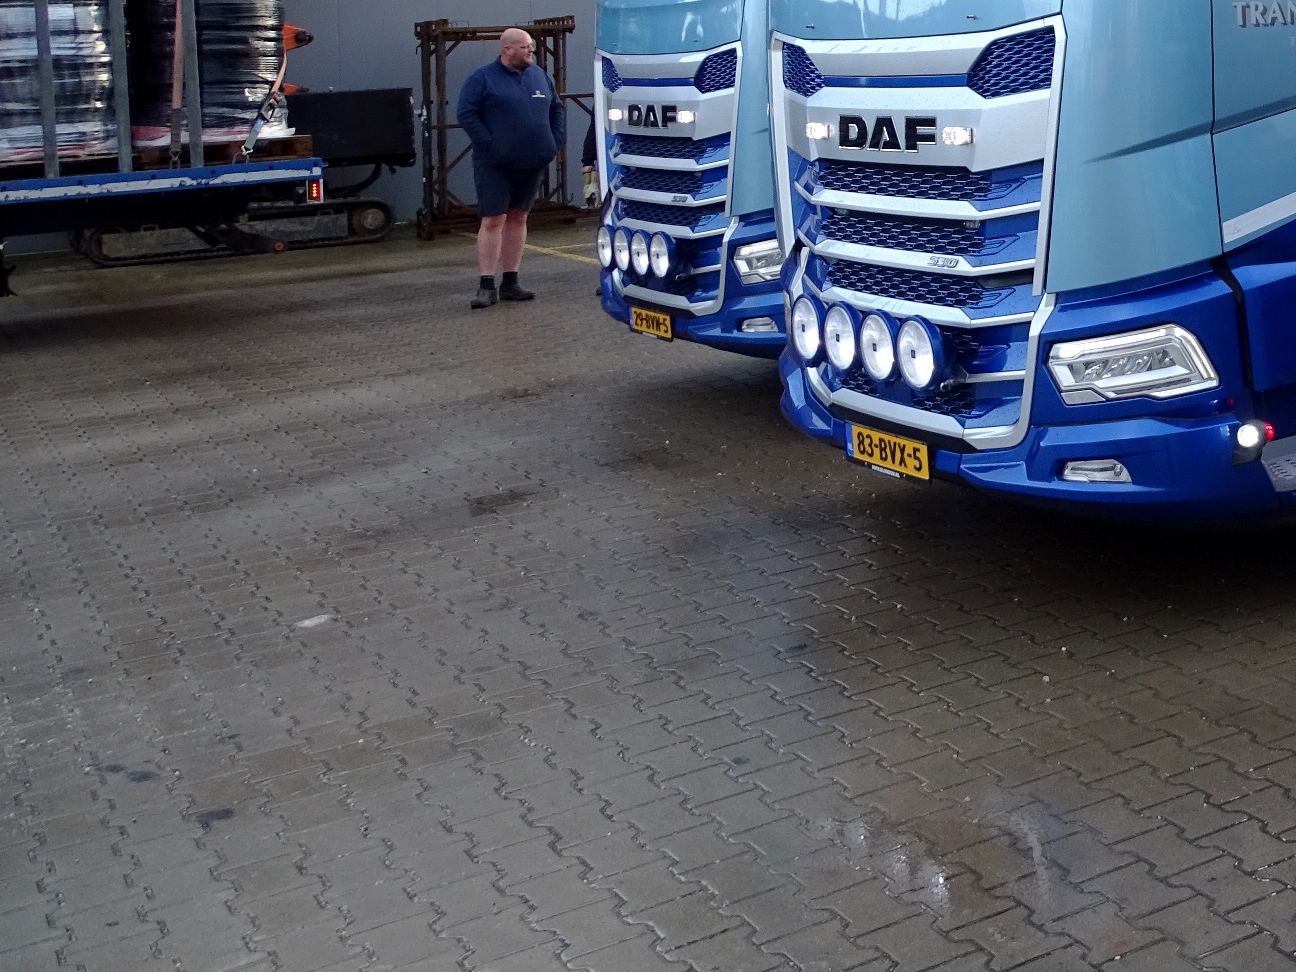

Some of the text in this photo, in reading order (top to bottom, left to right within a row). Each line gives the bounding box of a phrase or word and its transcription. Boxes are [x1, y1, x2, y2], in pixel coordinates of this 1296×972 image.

[627, 104, 677, 129] DAF
[838, 114, 937, 153] DAF
[856, 430, 923, 472] 83-BVX-5
